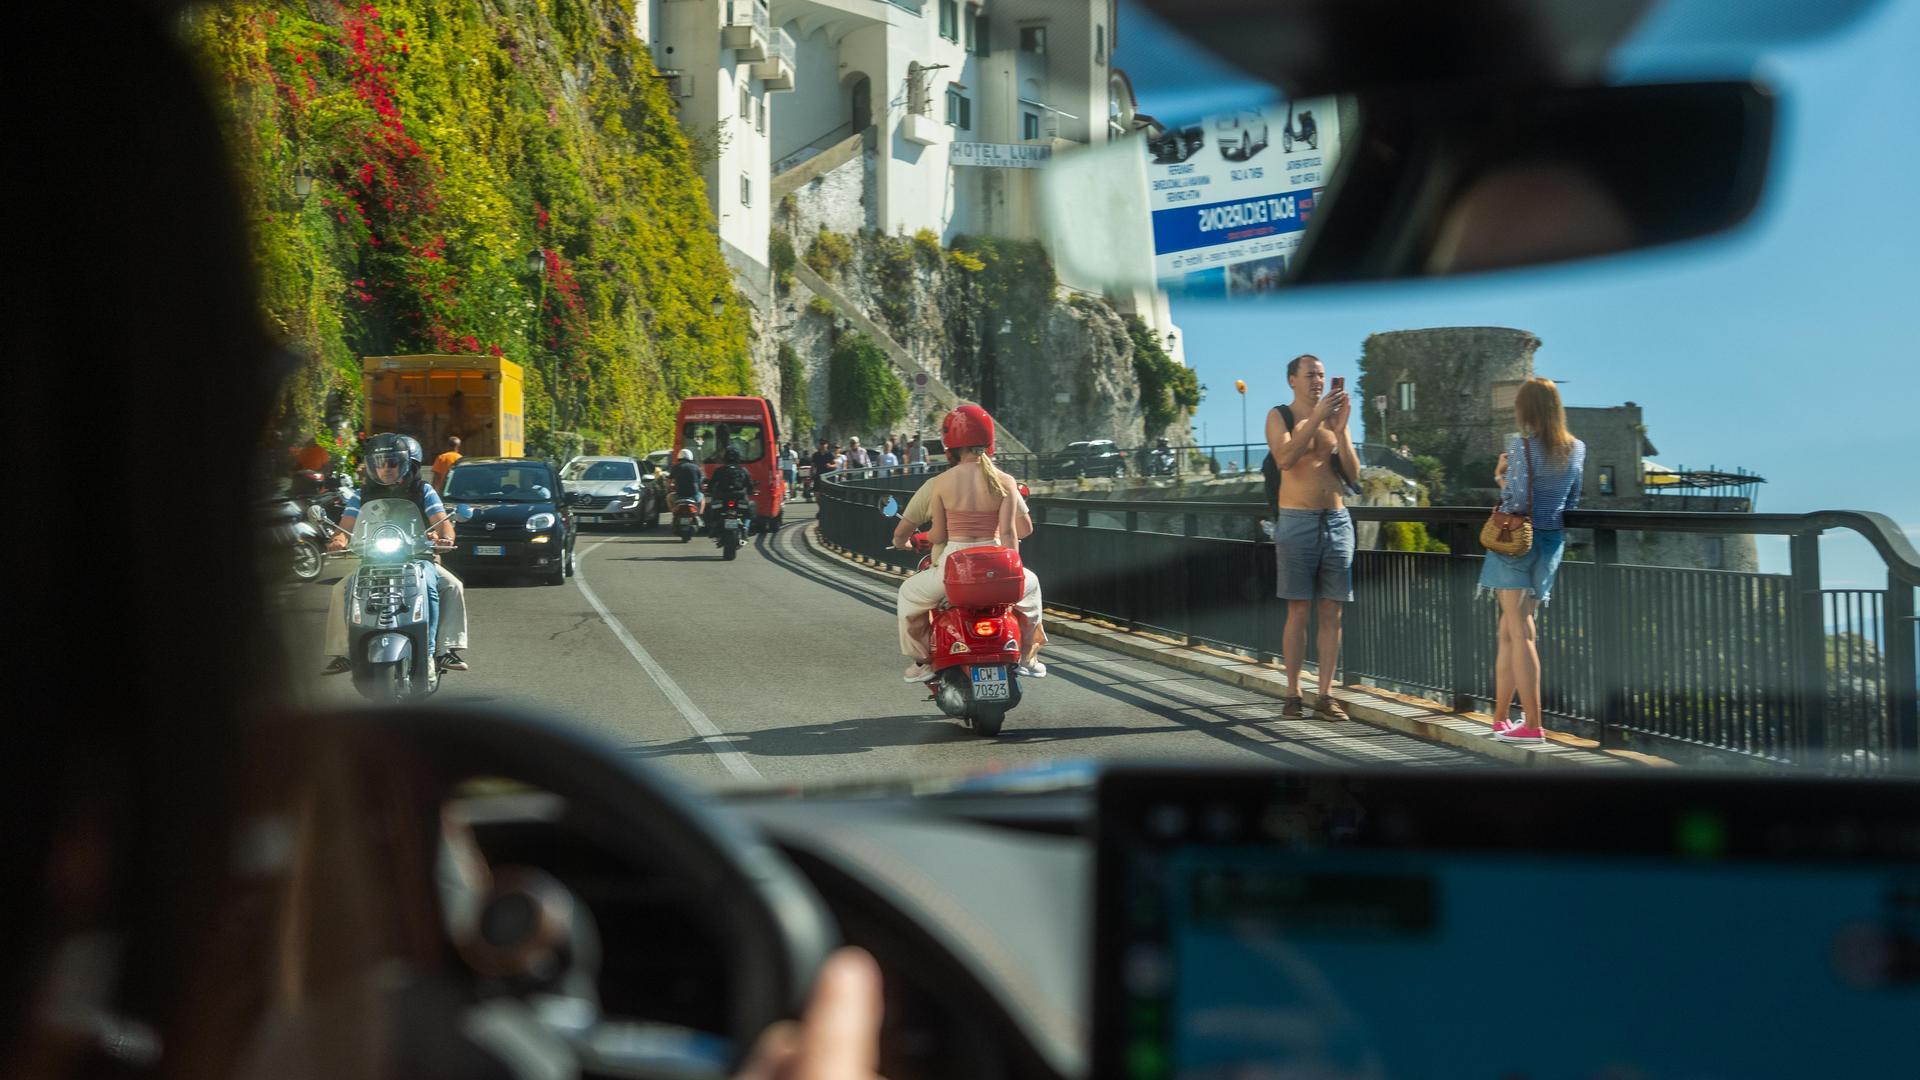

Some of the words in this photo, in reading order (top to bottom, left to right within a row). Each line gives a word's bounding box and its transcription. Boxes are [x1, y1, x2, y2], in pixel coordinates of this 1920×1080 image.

[953, 143, 1001, 158] HOTEL
[979, 668, 993, 681] CW
[975, 683, 1007, 697] 70323
